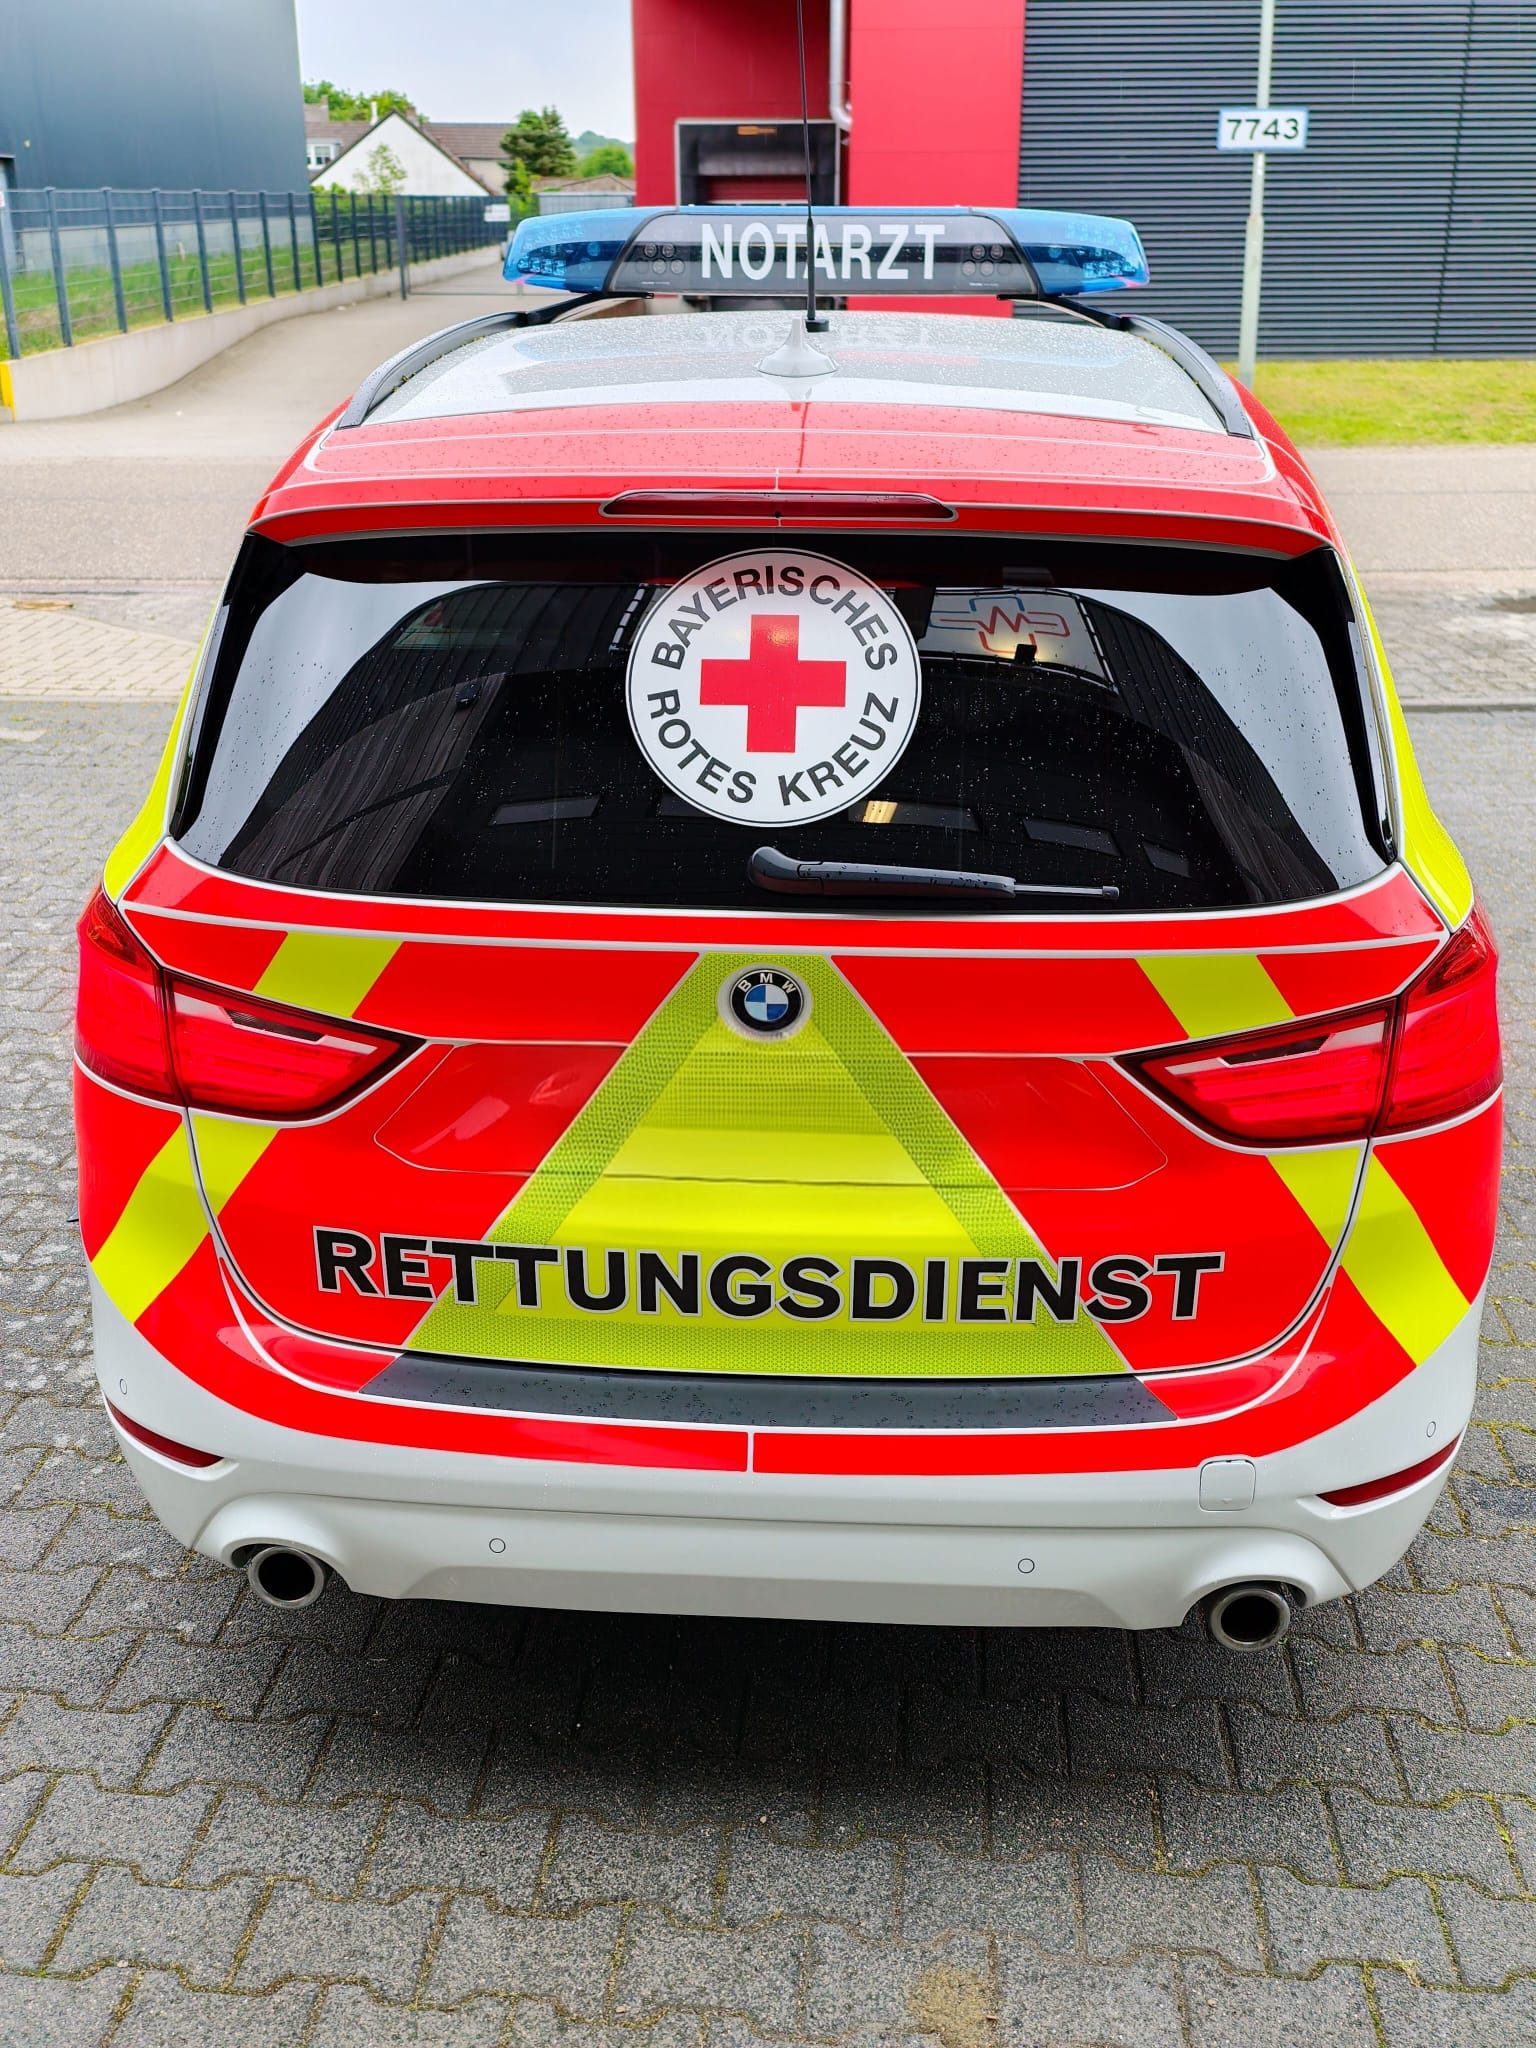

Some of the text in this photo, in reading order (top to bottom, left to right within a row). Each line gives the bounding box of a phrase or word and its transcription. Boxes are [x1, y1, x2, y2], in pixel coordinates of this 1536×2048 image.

[1227, 118, 1299, 140] 7743
[701, 222, 945, 280] NOTARZT
[651, 565, 898, 670] BAYERISCHES
[647, 688, 899, 806] ROTES KREUZ
[737, 972, 797, 994] BMW
[313, 1225, 1225, 1323] RETTUNGSDIENST
